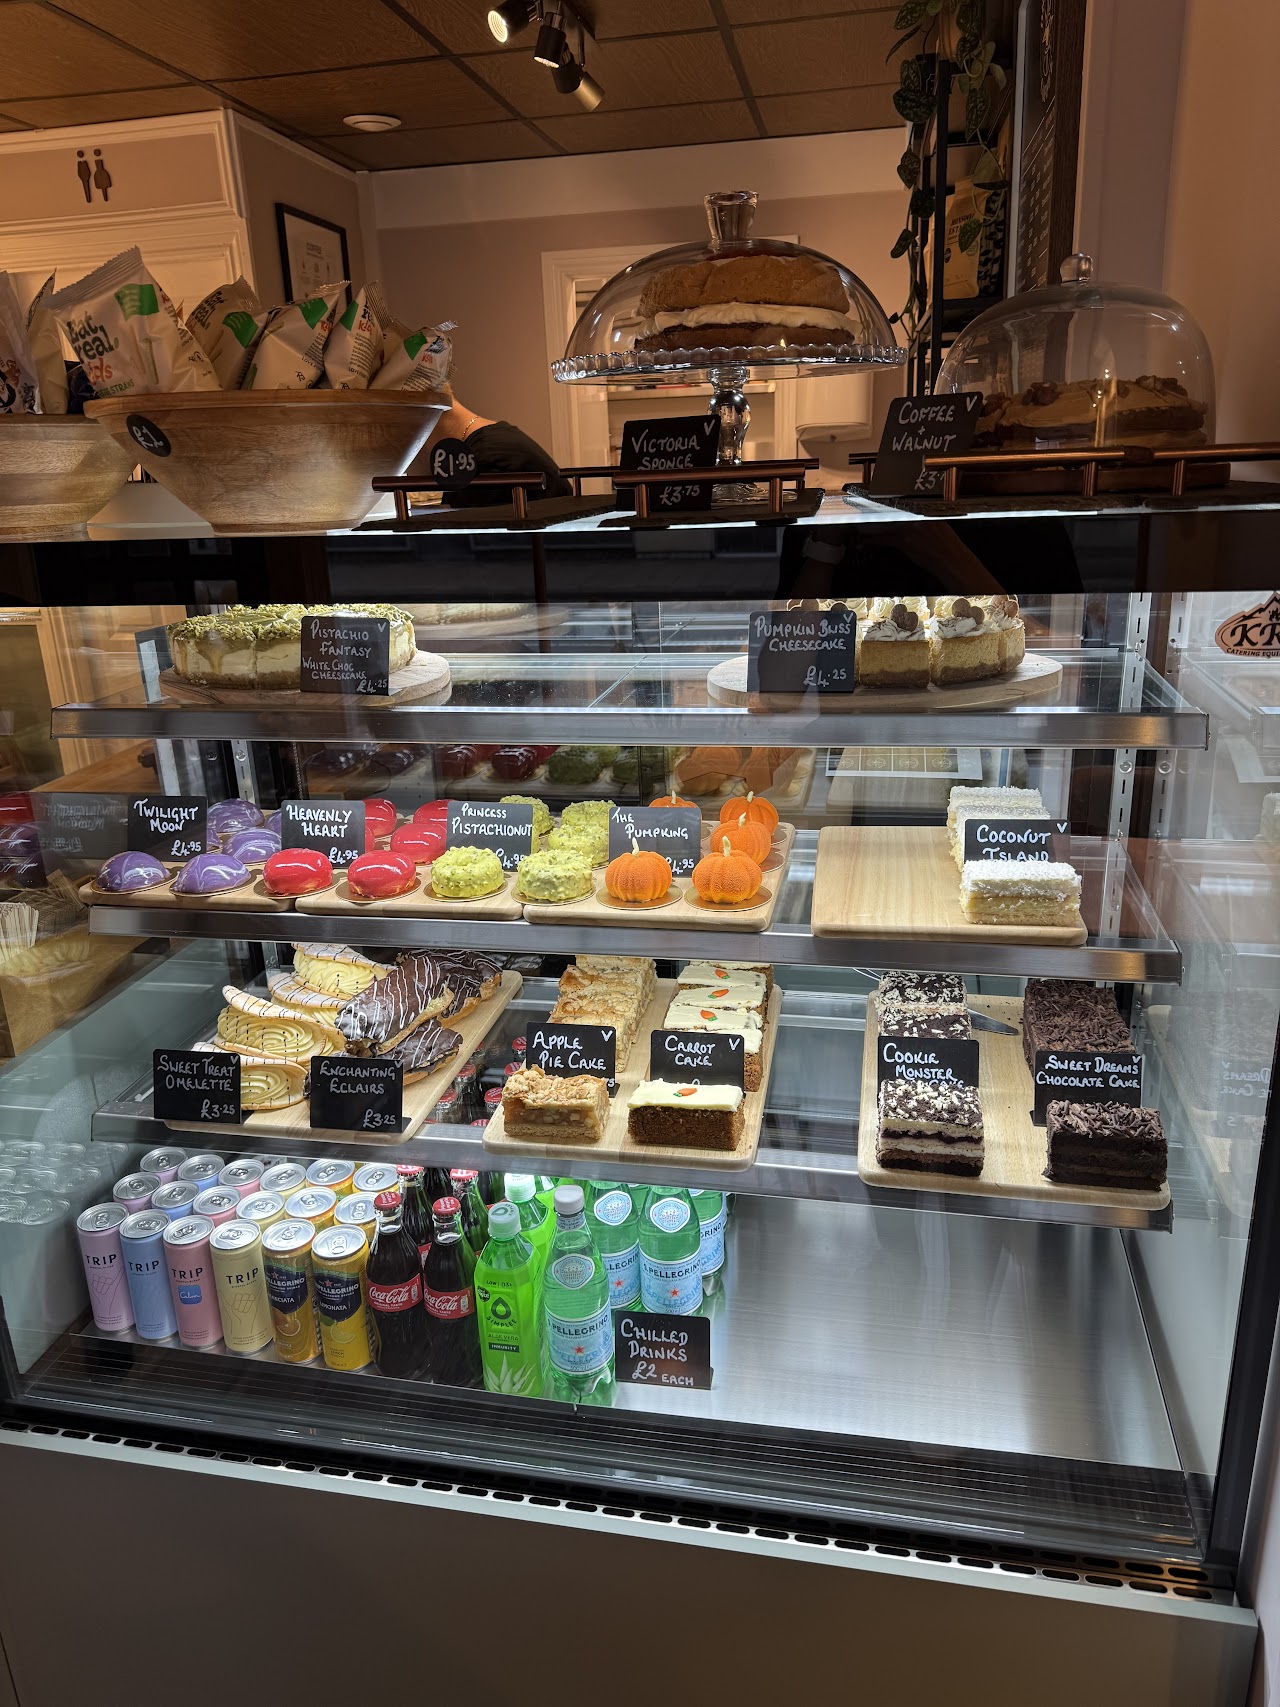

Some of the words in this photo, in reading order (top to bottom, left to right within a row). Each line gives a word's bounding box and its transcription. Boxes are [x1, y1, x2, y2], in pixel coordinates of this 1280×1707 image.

[66, 310, 98, 344] Eat
[898, 401, 955, 425] COFFEE
[966, 395, 978, 412] V
[631, 429, 700, 454] VICTORIA
[703, 419, 716, 436] V
[892, 432, 957, 452] WALNUT
[433, 449, 475, 478] £1.95
[637, 453, 694, 470] SPONGE
[659, 485, 701, 506] £3.75
[310, 619, 369, 641] PISTACHIO
[377, 622, 387, 633] V
[754, 615, 815, 638] PUMPKIN
[818, 619, 851, 637] BLISS
[843, 612, 854, 623] V
[319, 641, 372, 658] FANTASY
[768, 637, 847, 652] CHEESECAKE
[1226, 647, 1261, 657] CATERING
[302, 656, 330, 671] WHITE
[331, 659, 355, 671] CHOC
[311, 670, 367, 680] CHEESECAKE
[803, 665, 847, 687] £4.25
[356, 679, 388, 694] £4.25
[133, 798, 199, 821] TWILIGHT
[285, 804, 353, 824] HEAVENLY
[461, 802, 507, 819] PRINCESS
[611, 807, 635, 824] THE
[149, 818, 185, 833] MOON
[301, 821, 348, 838] HEART
[451, 816, 533, 837] PISTACHIONUT
[624, 823, 689, 840] PUMPKING
[976, 824, 1052, 844] COCONUT
[1056, 821, 1068, 834] V
[170, 839, 202, 857] £4.95
[328, 846, 359, 865] £4.95
[982, 847, 1050, 862] ISLAND
[531, 1030, 583, 1050] APPLE
[601, 1030, 614, 1042] V
[664, 1034, 716, 1055] CARROT
[728, 1037, 741, 1051] V
[538, 1050, 565, 1070] PIE
[567, 1050, 607, 1071] CAKE
[674, 1053, 713, 1068] CAKE
[883, 1042, 940, 1065] COOKIE
[157, 1054, 200, 1075] SWEET
[201, 1055, 236, 1077] TREAT
[230, 1055, 239, 1065] V
[319, 1060, 396, 1081] ENCHANTING
[895, 1064, 958, 1081] MONSTER
[1044, 1054, 1092, 1072] SWEET
[1094, 1056, 1139, 1075] DREAMS
[165, 1074, 234, 1092] OMELETTE
[329, 1077, 385, 1095] ECLAIRS
[1036, 1071, 1105, 1088] CHOCOLATE
[1108, 1074, 1141, 1089] CAKE
[200, 1098, 236, 1120] £3.25
[362, 1108, 396, 1129] £3.25
[85, 1253, 117, 1266] TRIP
[127, 1260, 160, 1272] TRIP
[171, 1267, 204, 1280] TRIP
[226, 1267, 259, 1285] TRIP
[369, 1285, 411, 1304] Coca-Cola
[486, 1315, 517, 1328] SIMPLEE
[620, 1318, 689, 1346] CHILLED
[628, 1340, 688, 1362] DRINKS
[631, 1360, 657, 1380] £2
[661, 1373, 694, 1386] EACH
